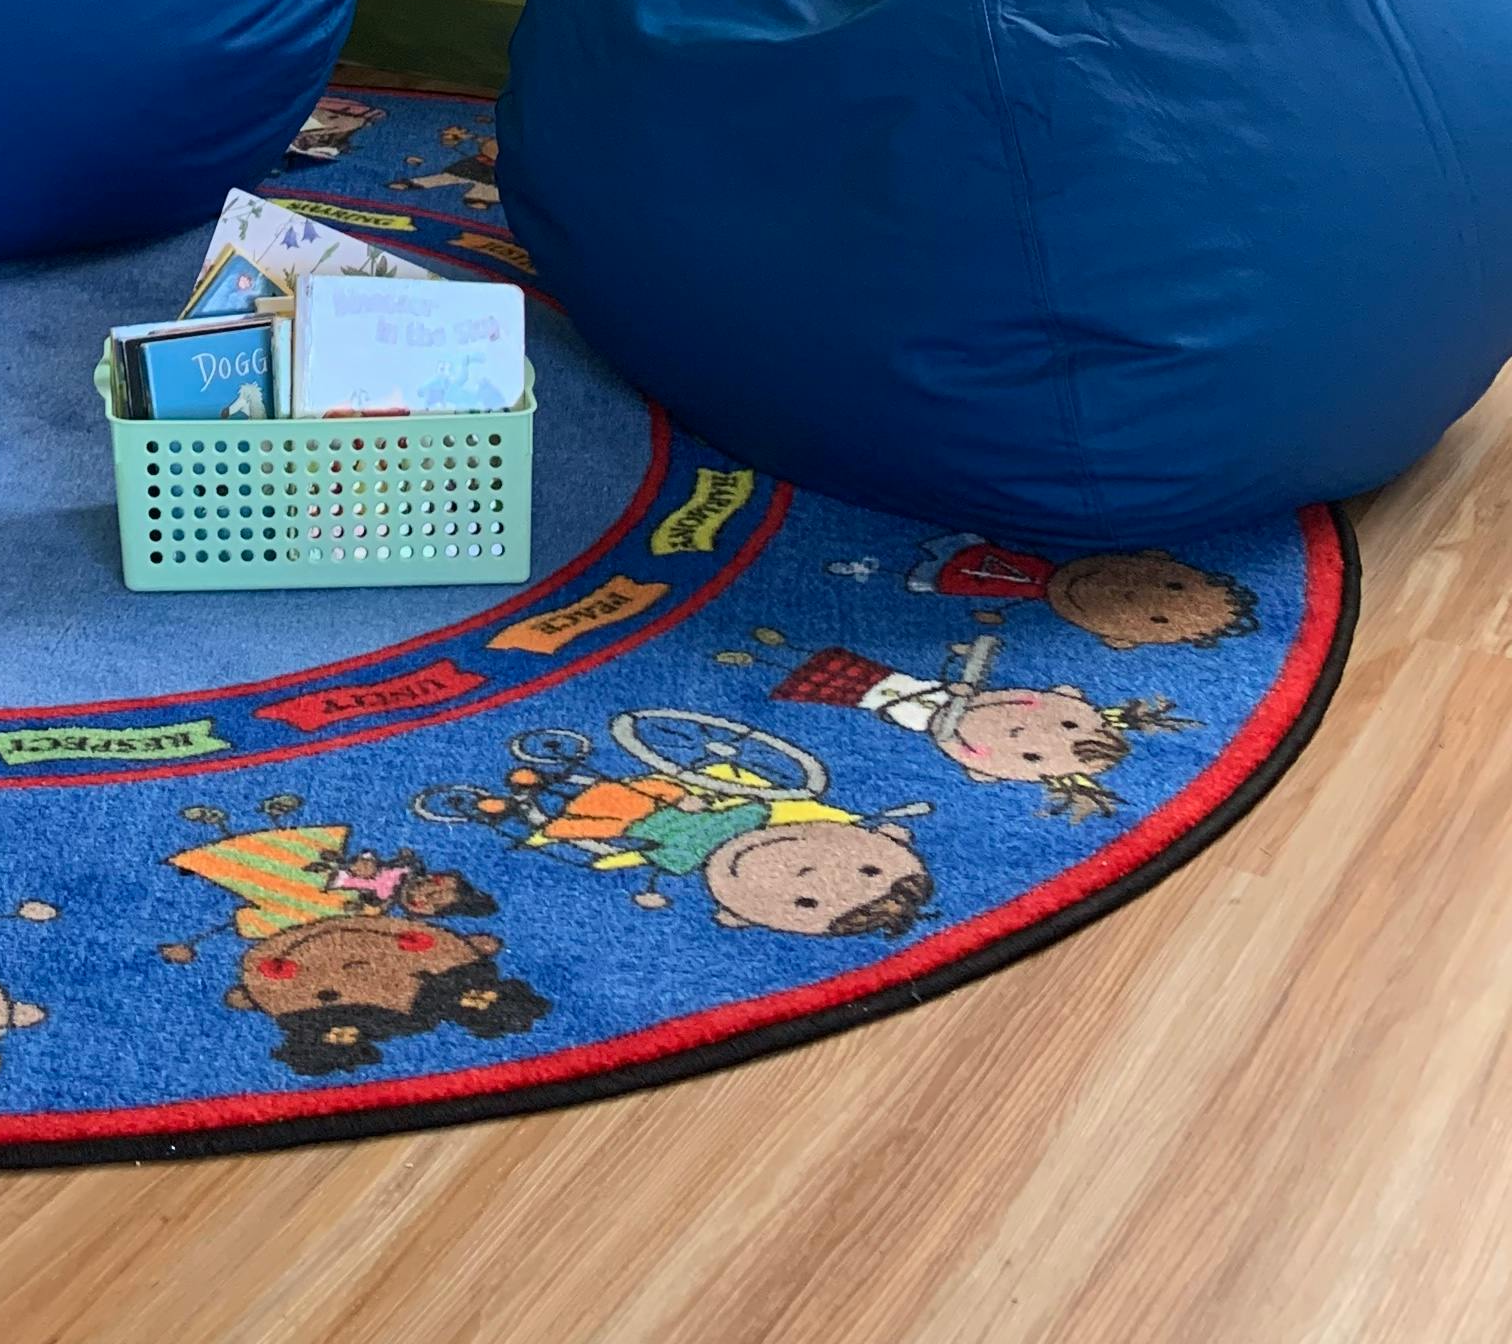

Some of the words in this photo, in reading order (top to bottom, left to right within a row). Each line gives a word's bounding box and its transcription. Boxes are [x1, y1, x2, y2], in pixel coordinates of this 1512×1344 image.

[286, 201, 394, 226] SHARING
[668, 473, 738, 549] HARMONY
[530, 591, 633, 635] PEACE
[322, 678, 449, 715] UNITY
[9, 730, 194, 754] RESPECT
